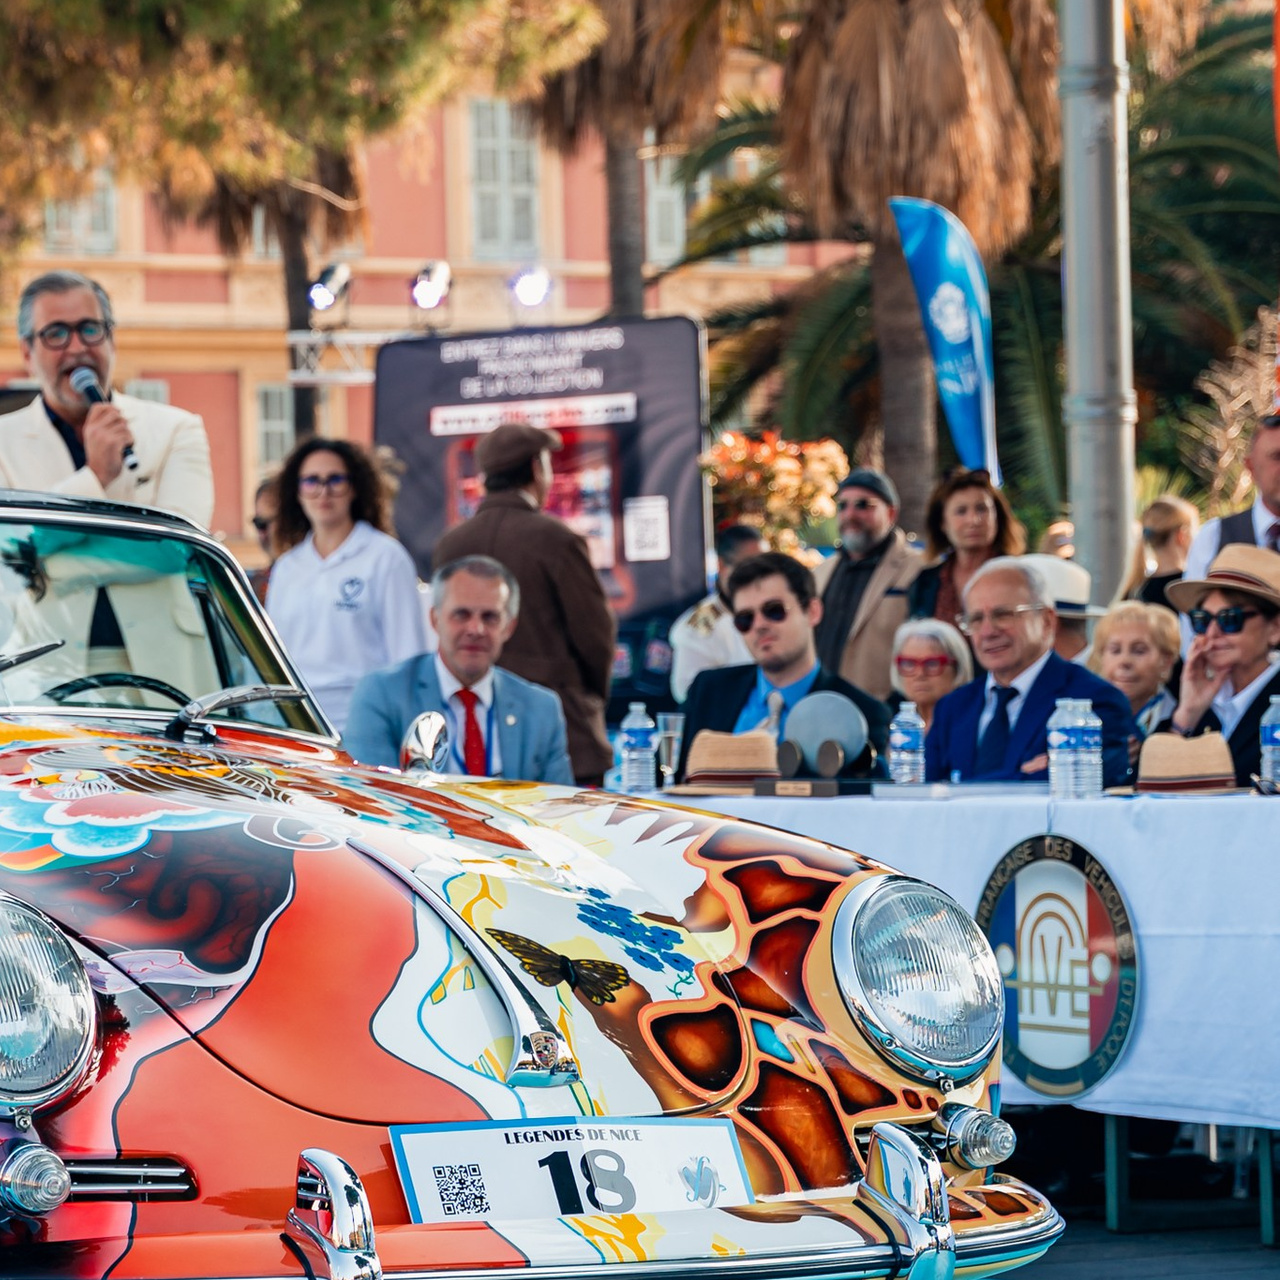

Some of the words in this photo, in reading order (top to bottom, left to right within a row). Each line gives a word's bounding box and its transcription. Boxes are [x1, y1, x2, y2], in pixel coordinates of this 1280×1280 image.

[1044, 836, 1074, 862] DES
[503, 1128, 585, 1145] LEGENDES
[587, 1128, 608, 1141] DE
[609, 1129, 643, 1142] NICE
[537, 1148, 637, 1216] 18
